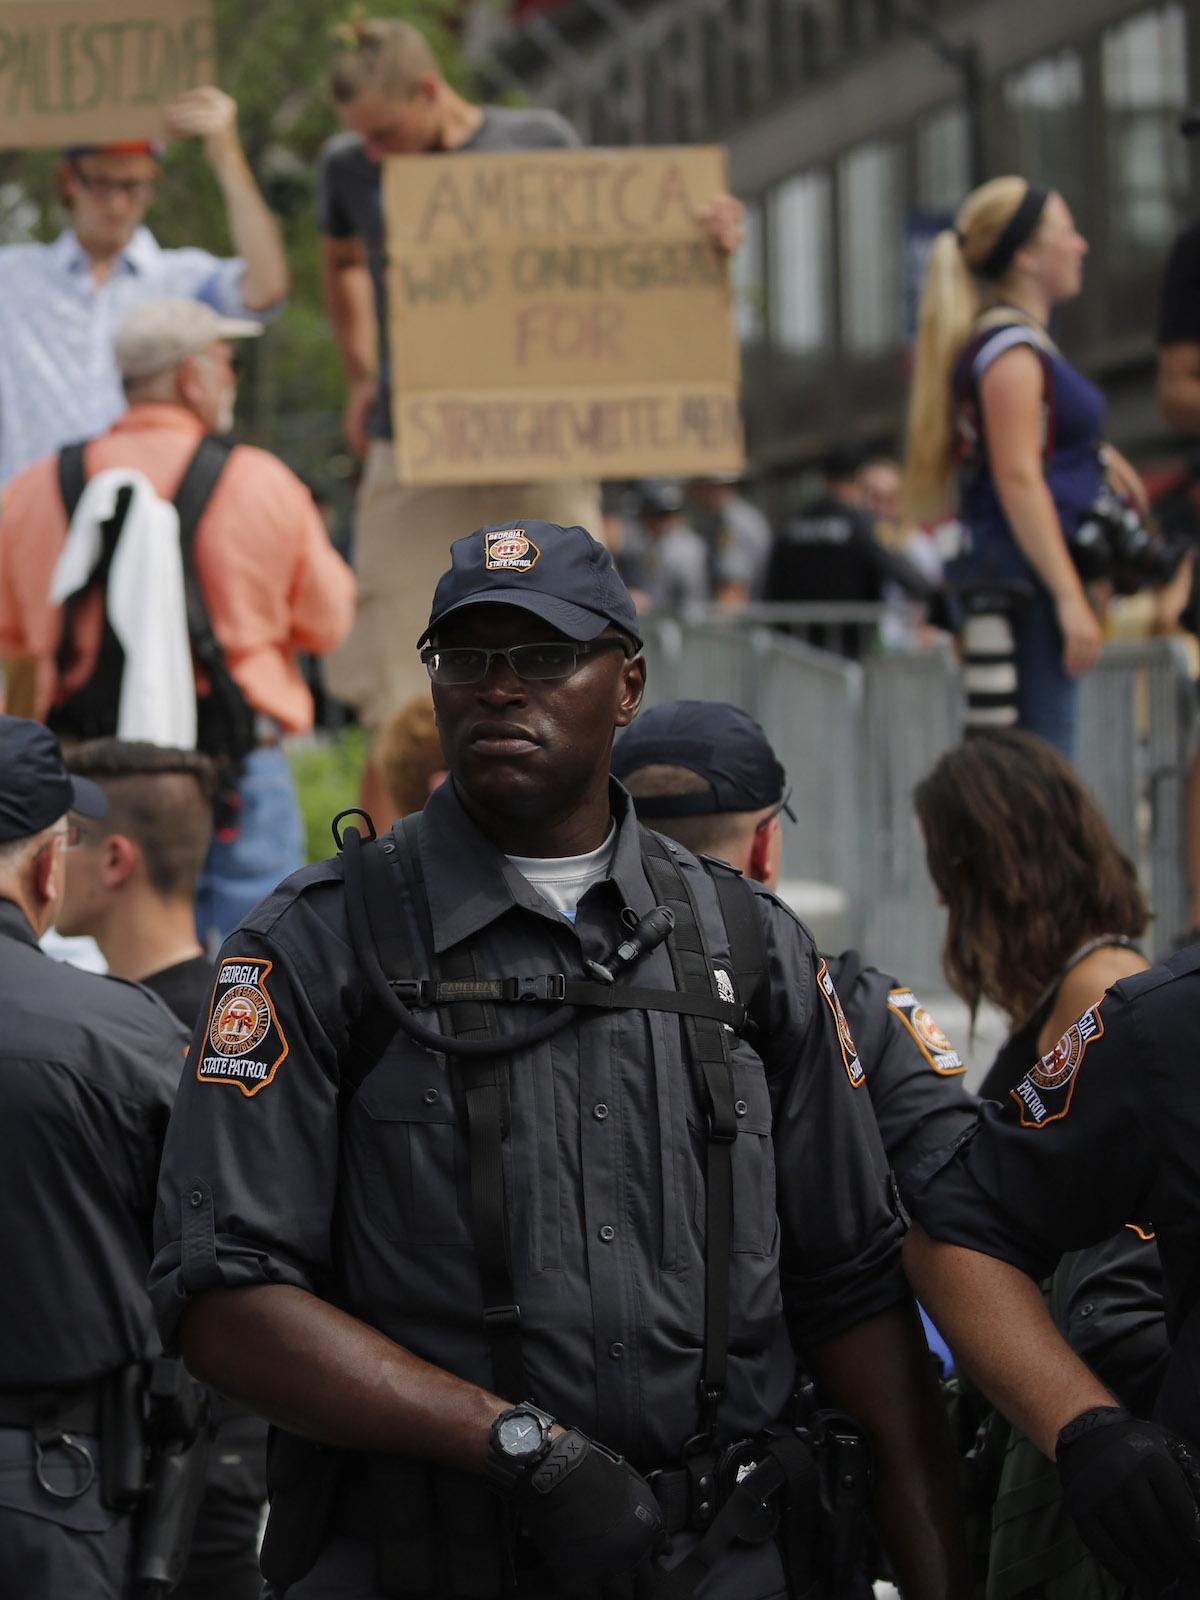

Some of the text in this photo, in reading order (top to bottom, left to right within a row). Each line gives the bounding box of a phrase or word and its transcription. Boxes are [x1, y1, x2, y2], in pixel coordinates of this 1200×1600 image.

[417, 162, 696, 243] AMERICA
[403, 247, 492, 305] WAS
[514, 302, 628, 368] FOR
[489, 531, 521, 541] GEORGIA
[219, 965, 260, 984] GEORGIA
[201, 1057, 268, 1080] STATE PATROL
[1016, 1080, 1048, 1123] PATROL
